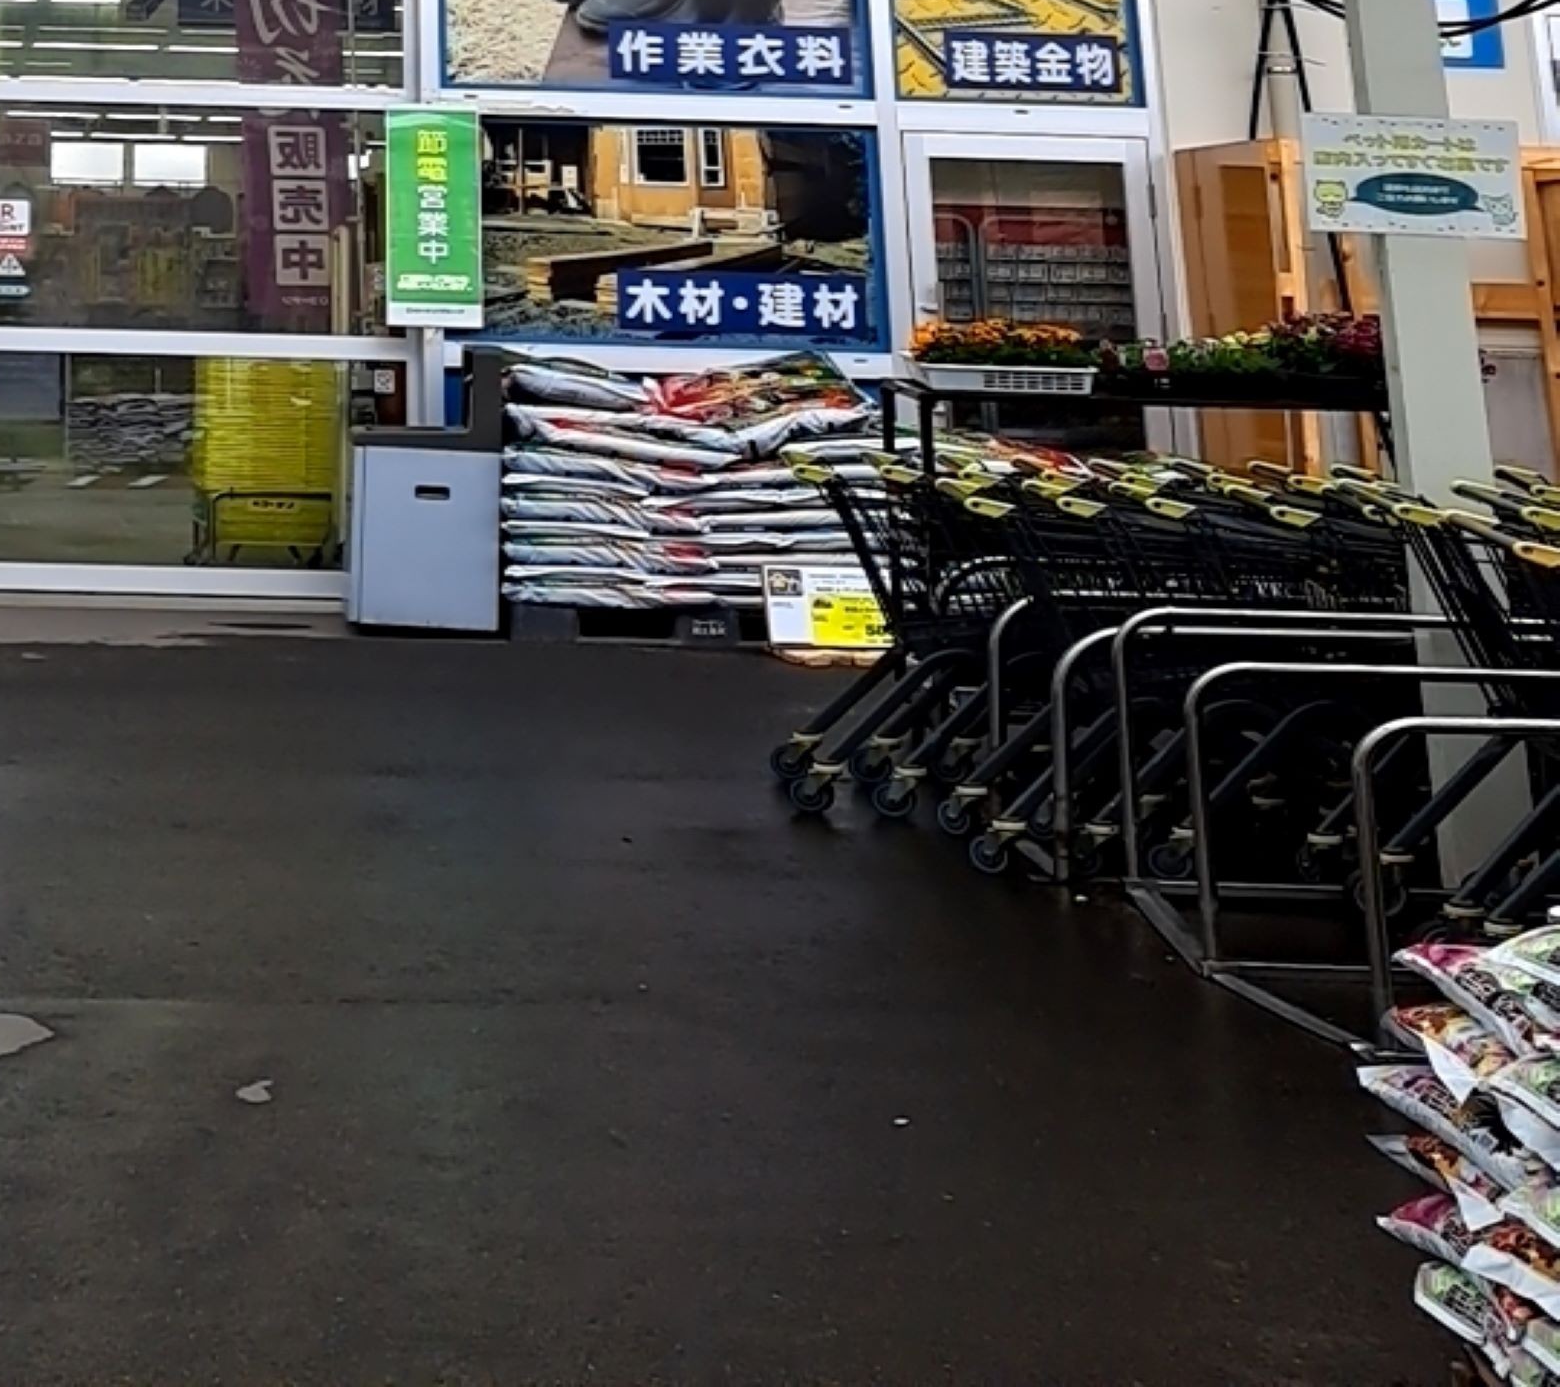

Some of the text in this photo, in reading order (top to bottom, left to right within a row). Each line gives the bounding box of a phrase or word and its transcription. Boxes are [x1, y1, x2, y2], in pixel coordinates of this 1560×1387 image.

[616, 31, 844, 78] 作業衣料
[951, 40, 1115, 87] 建築金物
[416, 129, 448, 265] 節電営業中
[624, 277, 859, 328] 木材・建材
